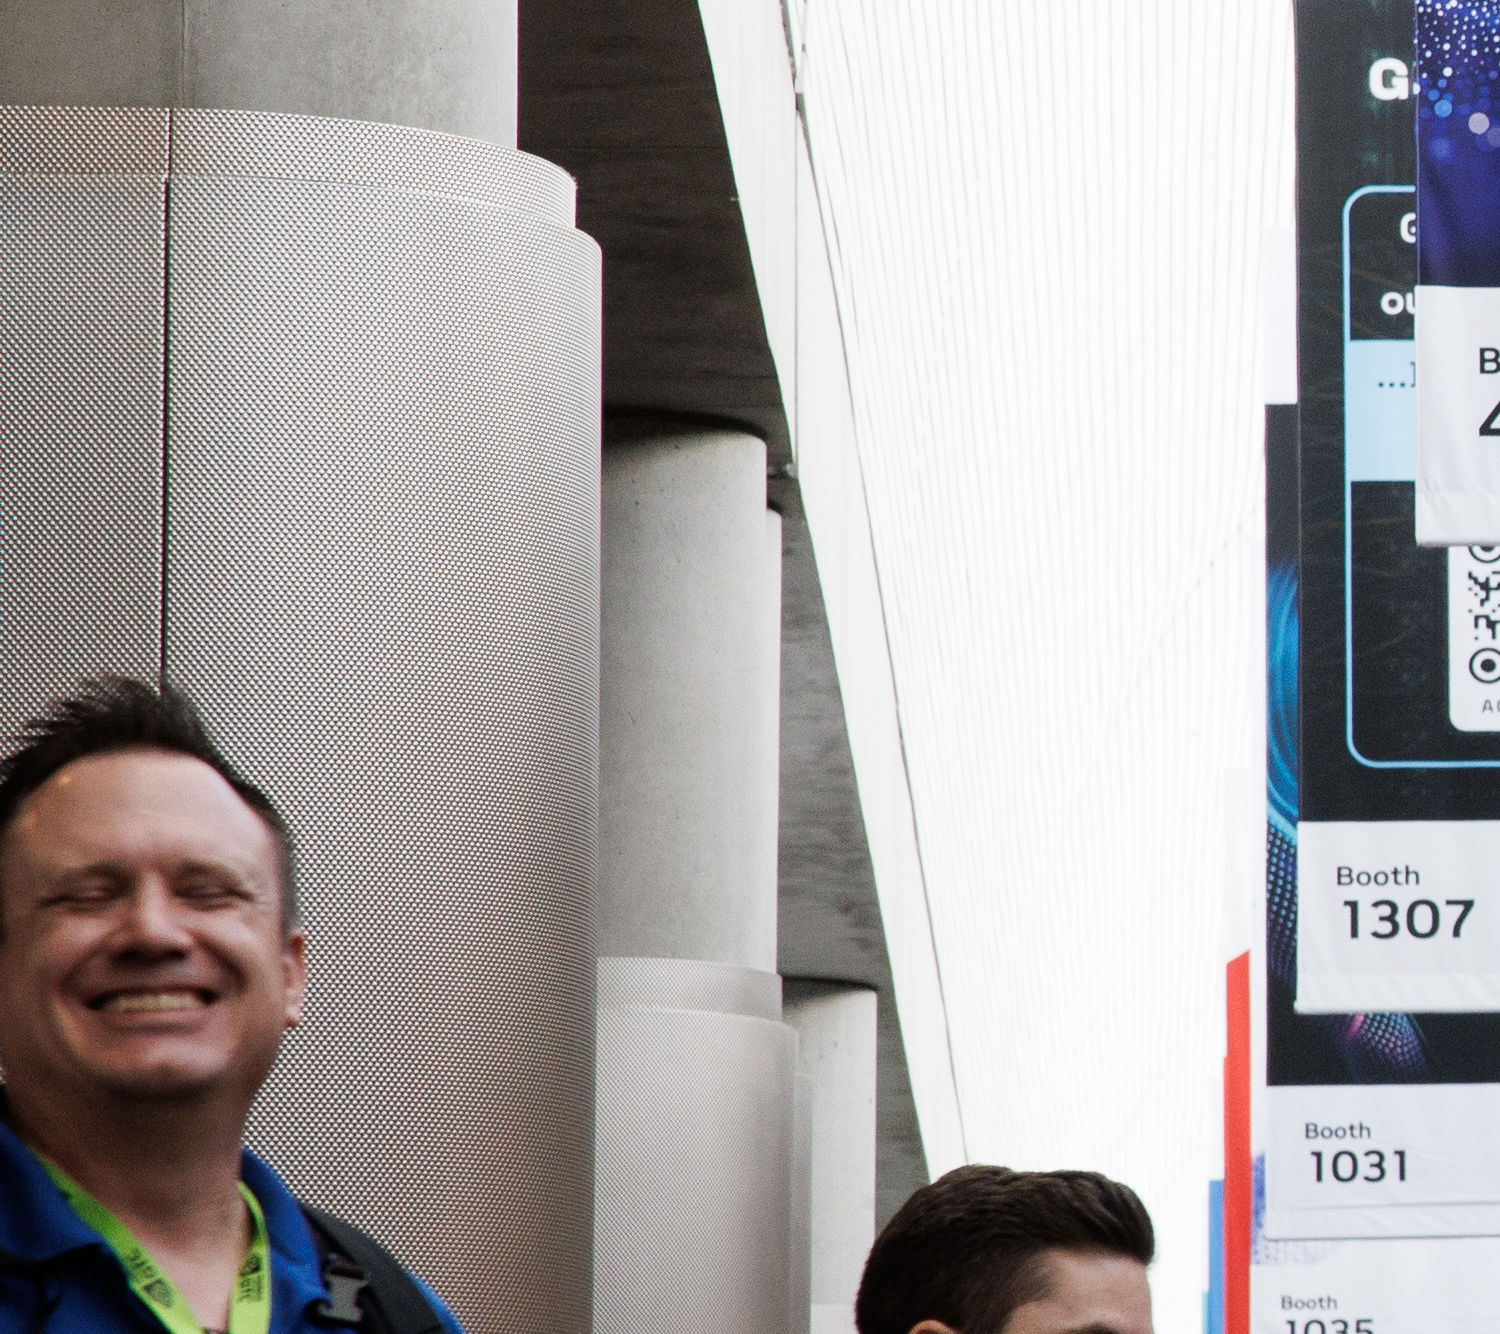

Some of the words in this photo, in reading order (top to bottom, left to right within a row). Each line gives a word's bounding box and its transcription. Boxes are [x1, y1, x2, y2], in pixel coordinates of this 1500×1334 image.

[1335, 863, 1421, 888] Booth
[1343, 898, 1476, 940] 1307
[1304, 1122, 1372, 1141] Booth
[1310, 1149, 1409, 1184] 1031
[1280, 1294, 1339, 1311] Booth
